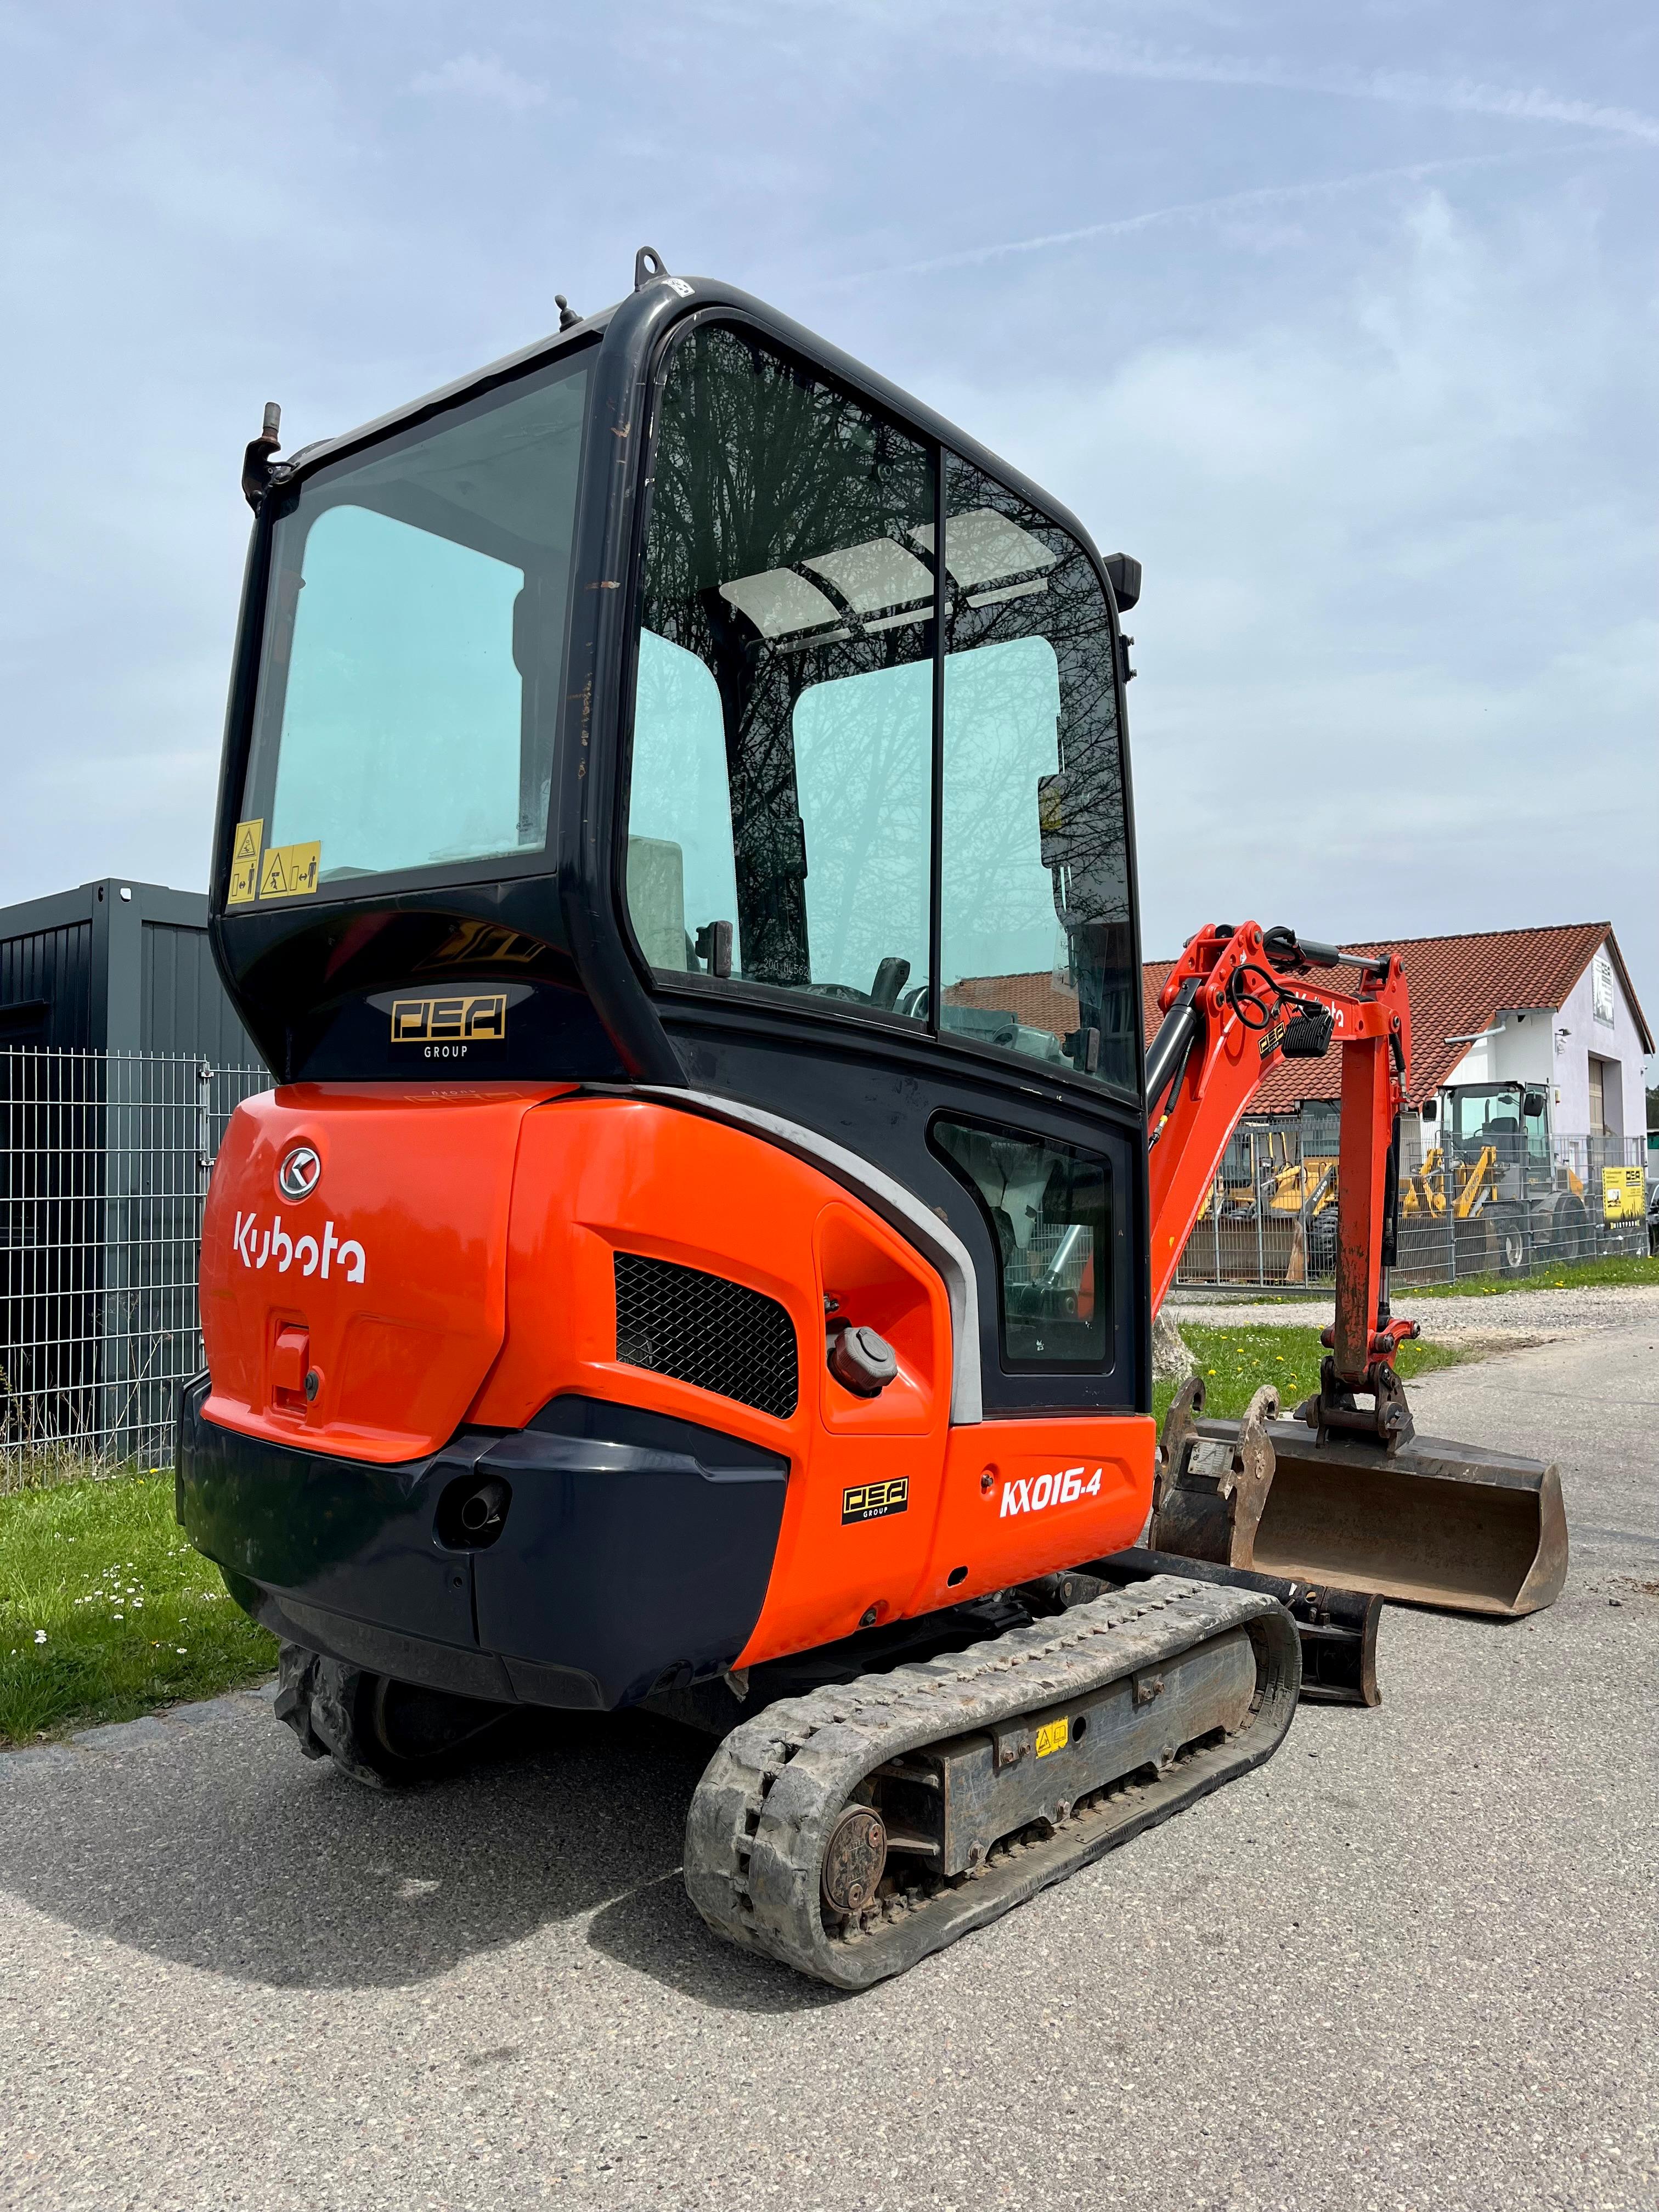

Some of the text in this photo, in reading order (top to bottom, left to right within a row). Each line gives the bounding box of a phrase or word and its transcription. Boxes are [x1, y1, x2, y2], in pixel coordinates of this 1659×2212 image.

[424, 1046, 467, 1058] GROUP
[233, 1211, 366, 1283] Kubota
[863, 1506, 888, 1518] GROUP
